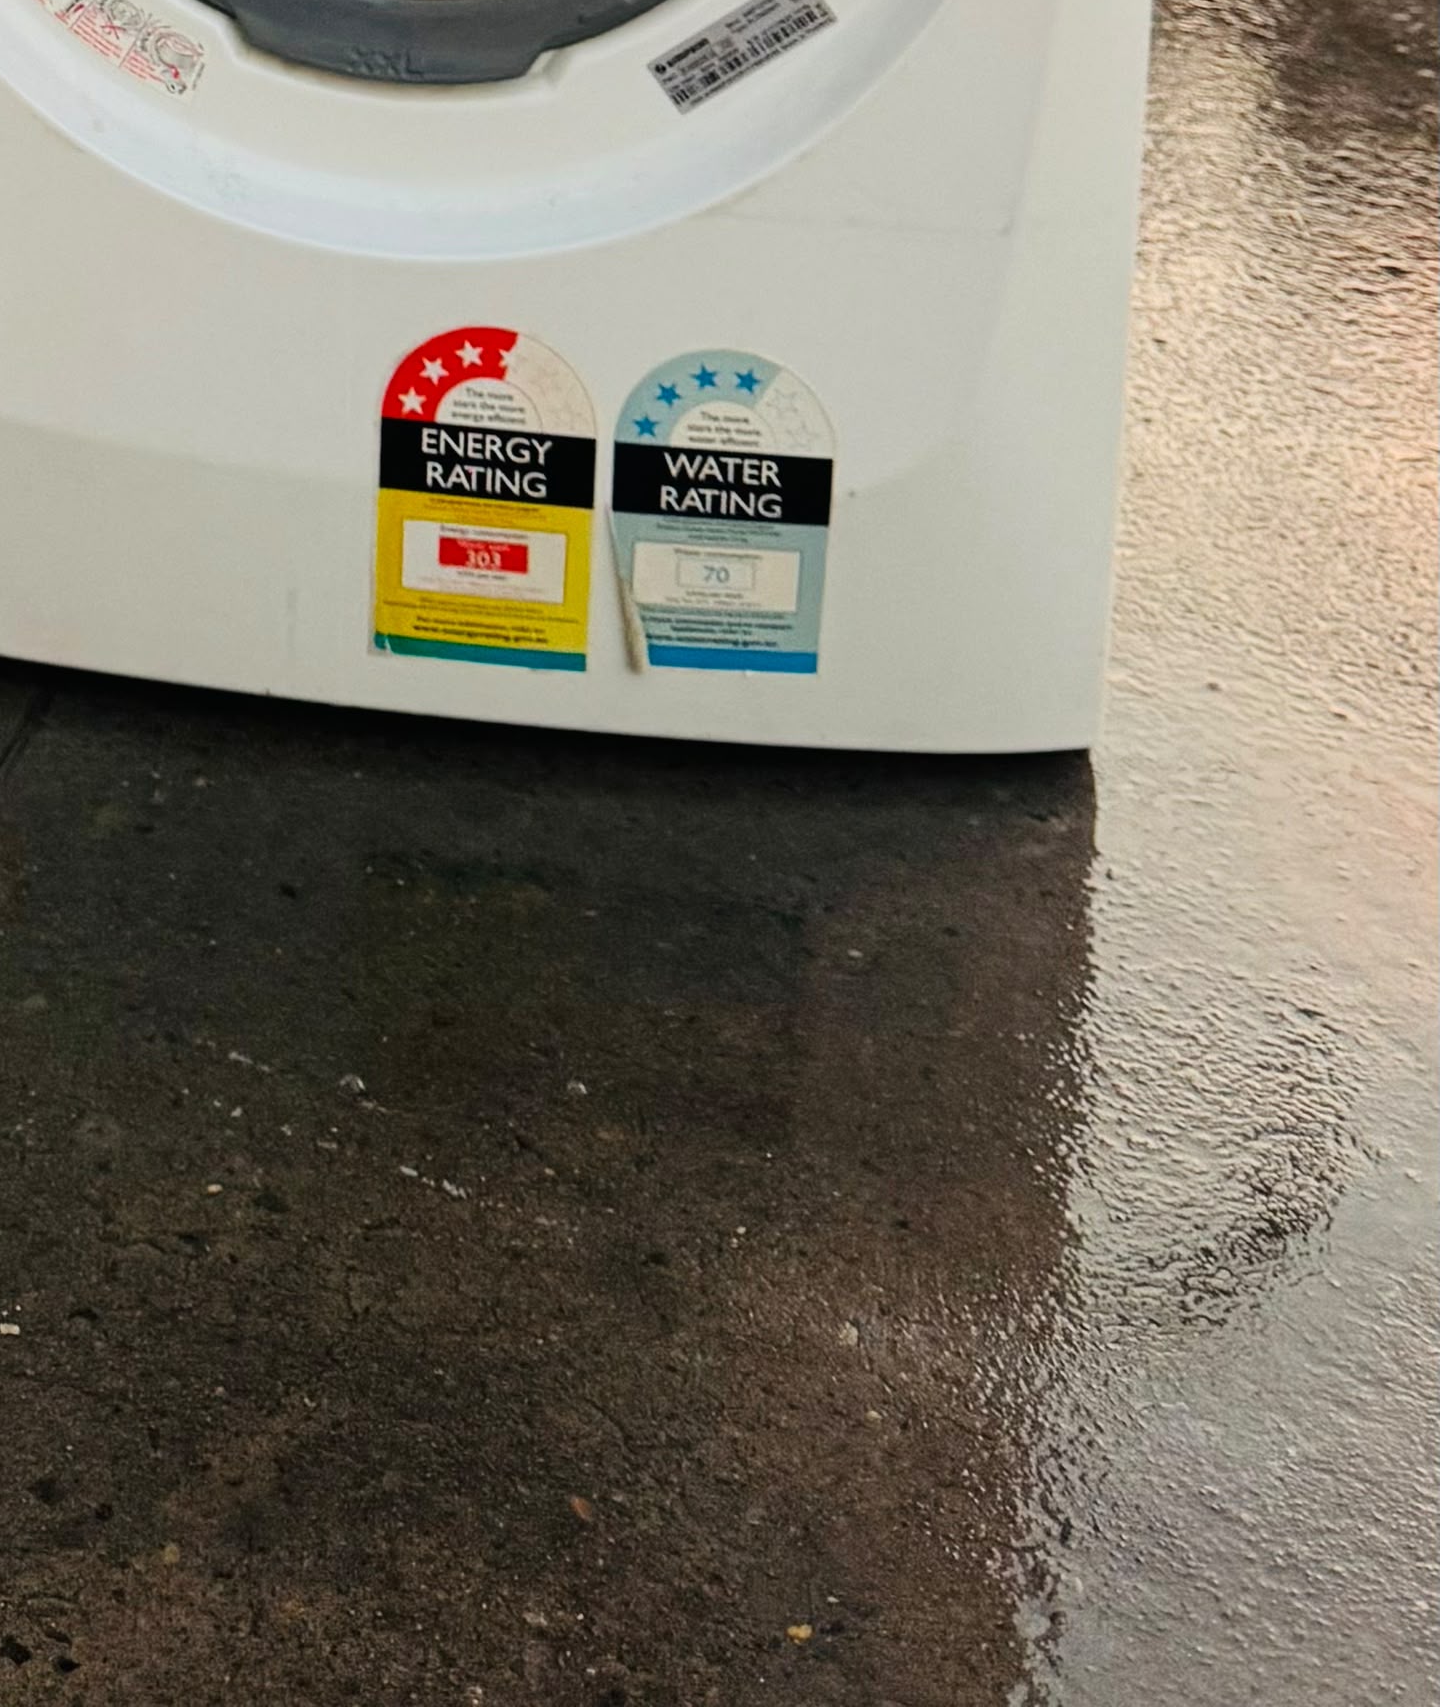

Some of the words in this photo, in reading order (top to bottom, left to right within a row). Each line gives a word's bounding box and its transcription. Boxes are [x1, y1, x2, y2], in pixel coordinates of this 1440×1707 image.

[420, 427, 553, 466] ENERGY
[425, 460, 548, 499] RATING
[663, 451, 782, 488] WATER
[659, 484, 784, 519] RATING
[466, 549, 502, 569] 303
[703, 565, 730, 583] 70
